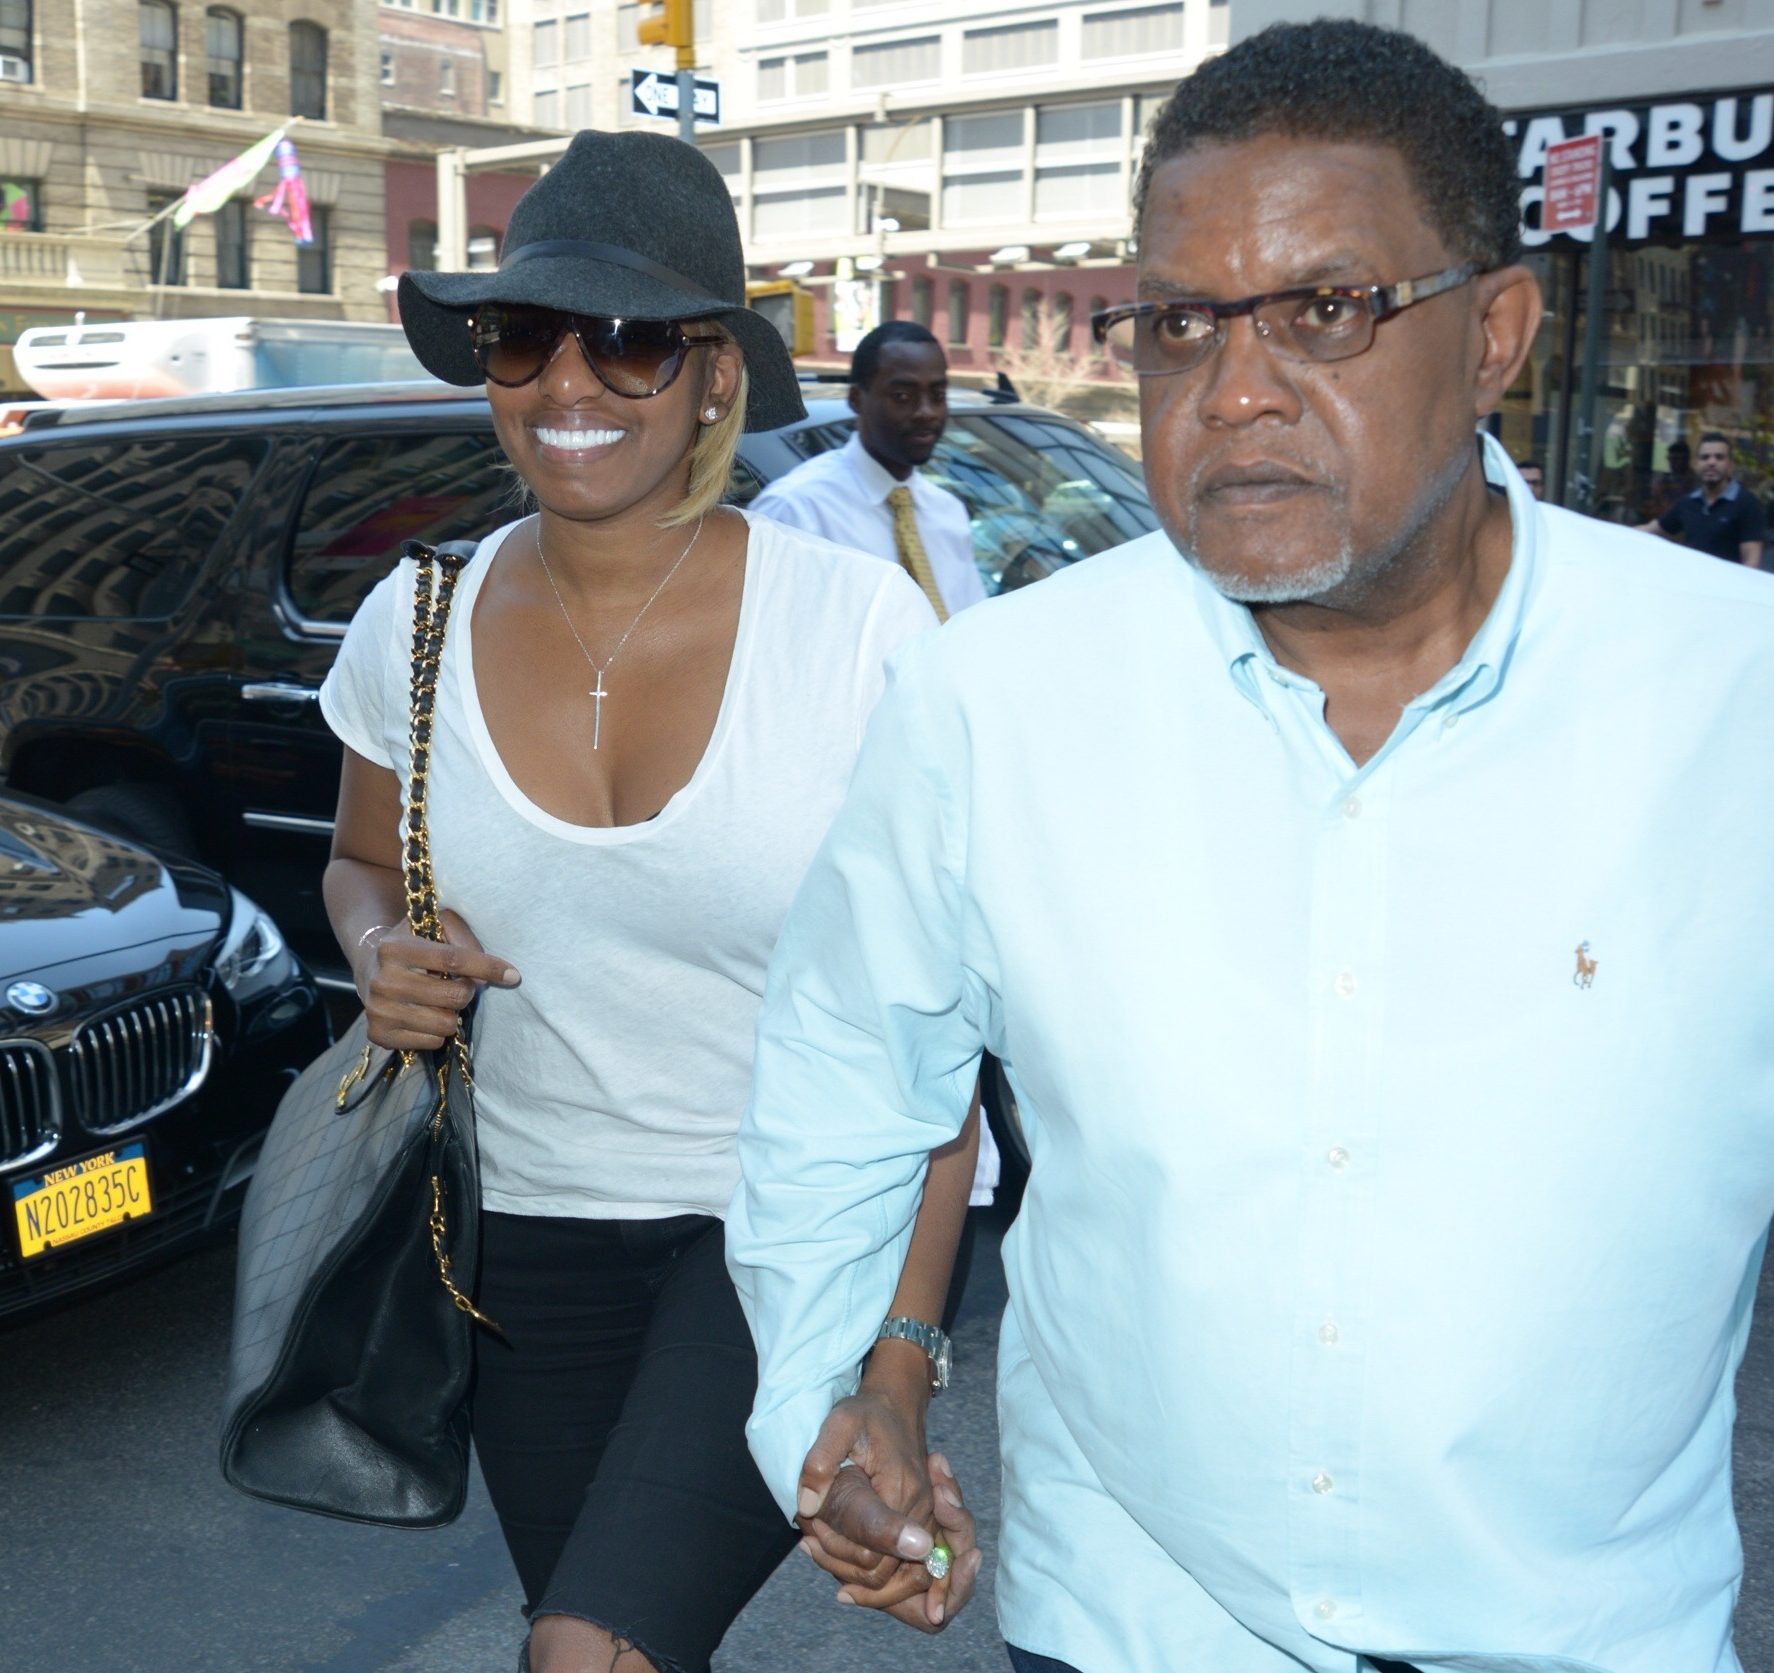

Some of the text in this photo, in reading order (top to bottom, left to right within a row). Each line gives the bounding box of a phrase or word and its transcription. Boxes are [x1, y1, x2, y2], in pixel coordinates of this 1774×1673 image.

[1502, 94, 1774, 179] ARBU
[24, 1165, 140, 1241] N202835C
[44, 1151, 115, 1187] NEW YORK
